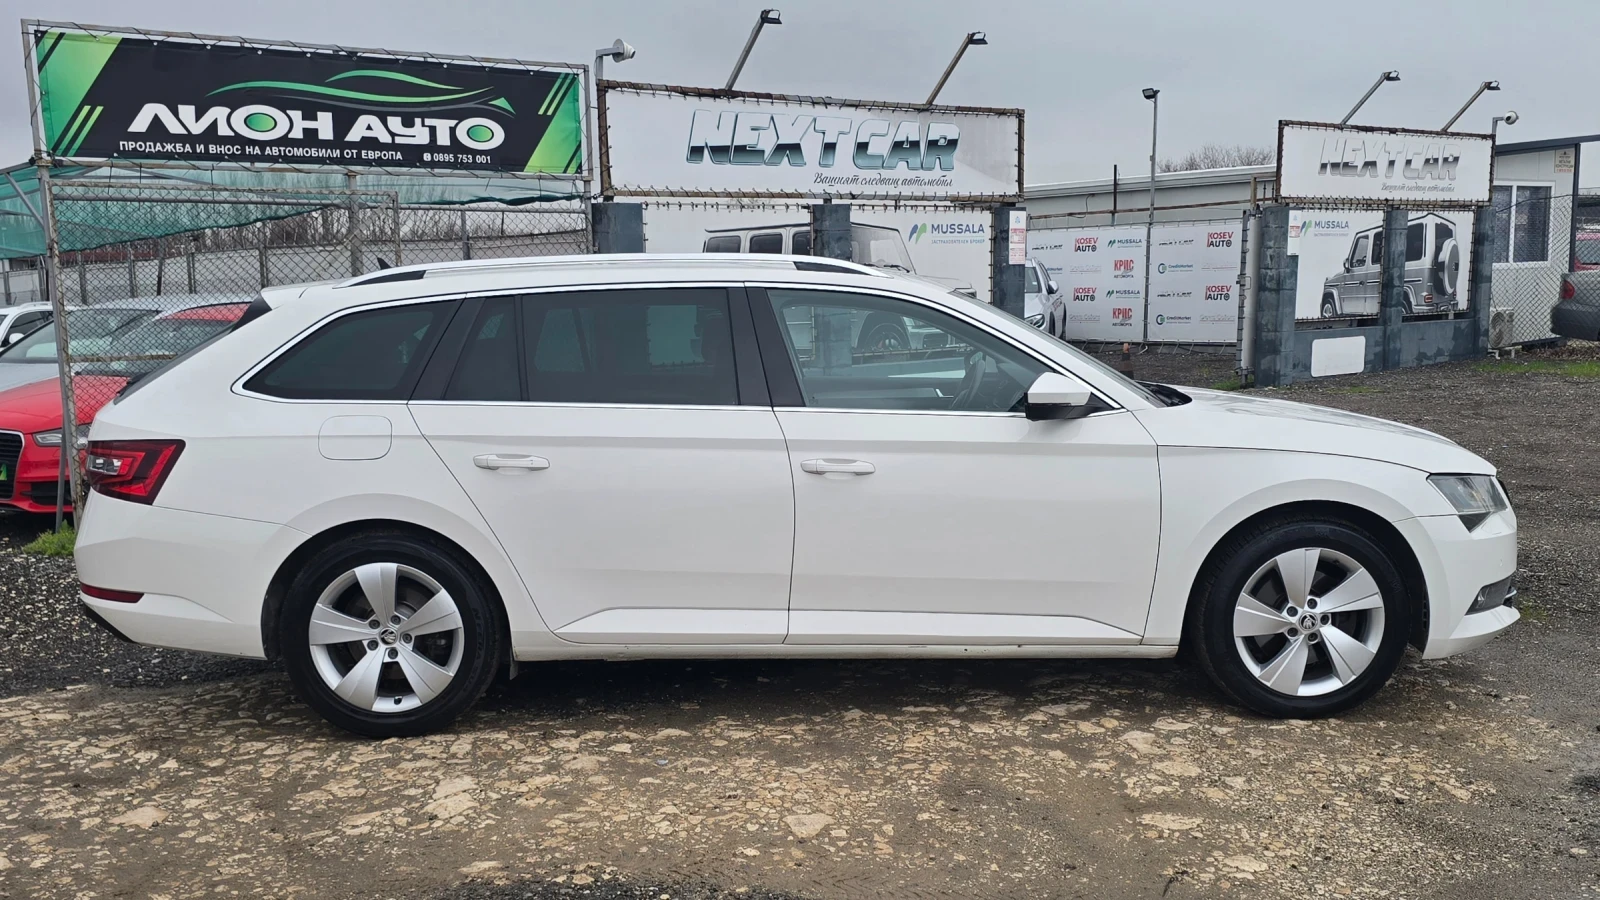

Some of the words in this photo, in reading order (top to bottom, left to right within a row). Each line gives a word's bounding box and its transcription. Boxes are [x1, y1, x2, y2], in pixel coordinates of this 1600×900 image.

[127, 102, 334, 141] ЛИОН
[344, 114, 505, 151] АУТО
[686, 109, 961, 171] NEXTCAR
[119, 141, 192, 154] ПРОДАЖБА
[196, 144, 205, 154] И
[209, 144, 242, 155] ВНОС
[245, 145, 262, 156] НА
[264, 147, 341, 159] АВТОМОБИЛИ
[343, 149, 358, 160] ОТ
[361, 150, 403, 161] ЕВРОПА
[433, 153, 455, 163] 0895
[457, 154, 473, 164] 753
[476, 155, 491, 164] 001
[1318, 136, 1461, 181] NEXTCAR
[813, 172, 860, 187] Вашият
[860, 172, 900, 189] следващ
[901, 174, 954, 187] автомобил
[931, 223, 985, 234] MUSSALA
[1314, 220, 1349, 229] MUSSALA
[1208, 231, 1234, 240] KOSEV
[1075, 237, 1099, 245] KOSEV
[1208, 239, 1233, 248] AUTO
[1076, 244, 1097, 252] AUTO
[1205, 285, 1232, 293] KOSEV
[1206, 293, 1230, 301] AUTO
